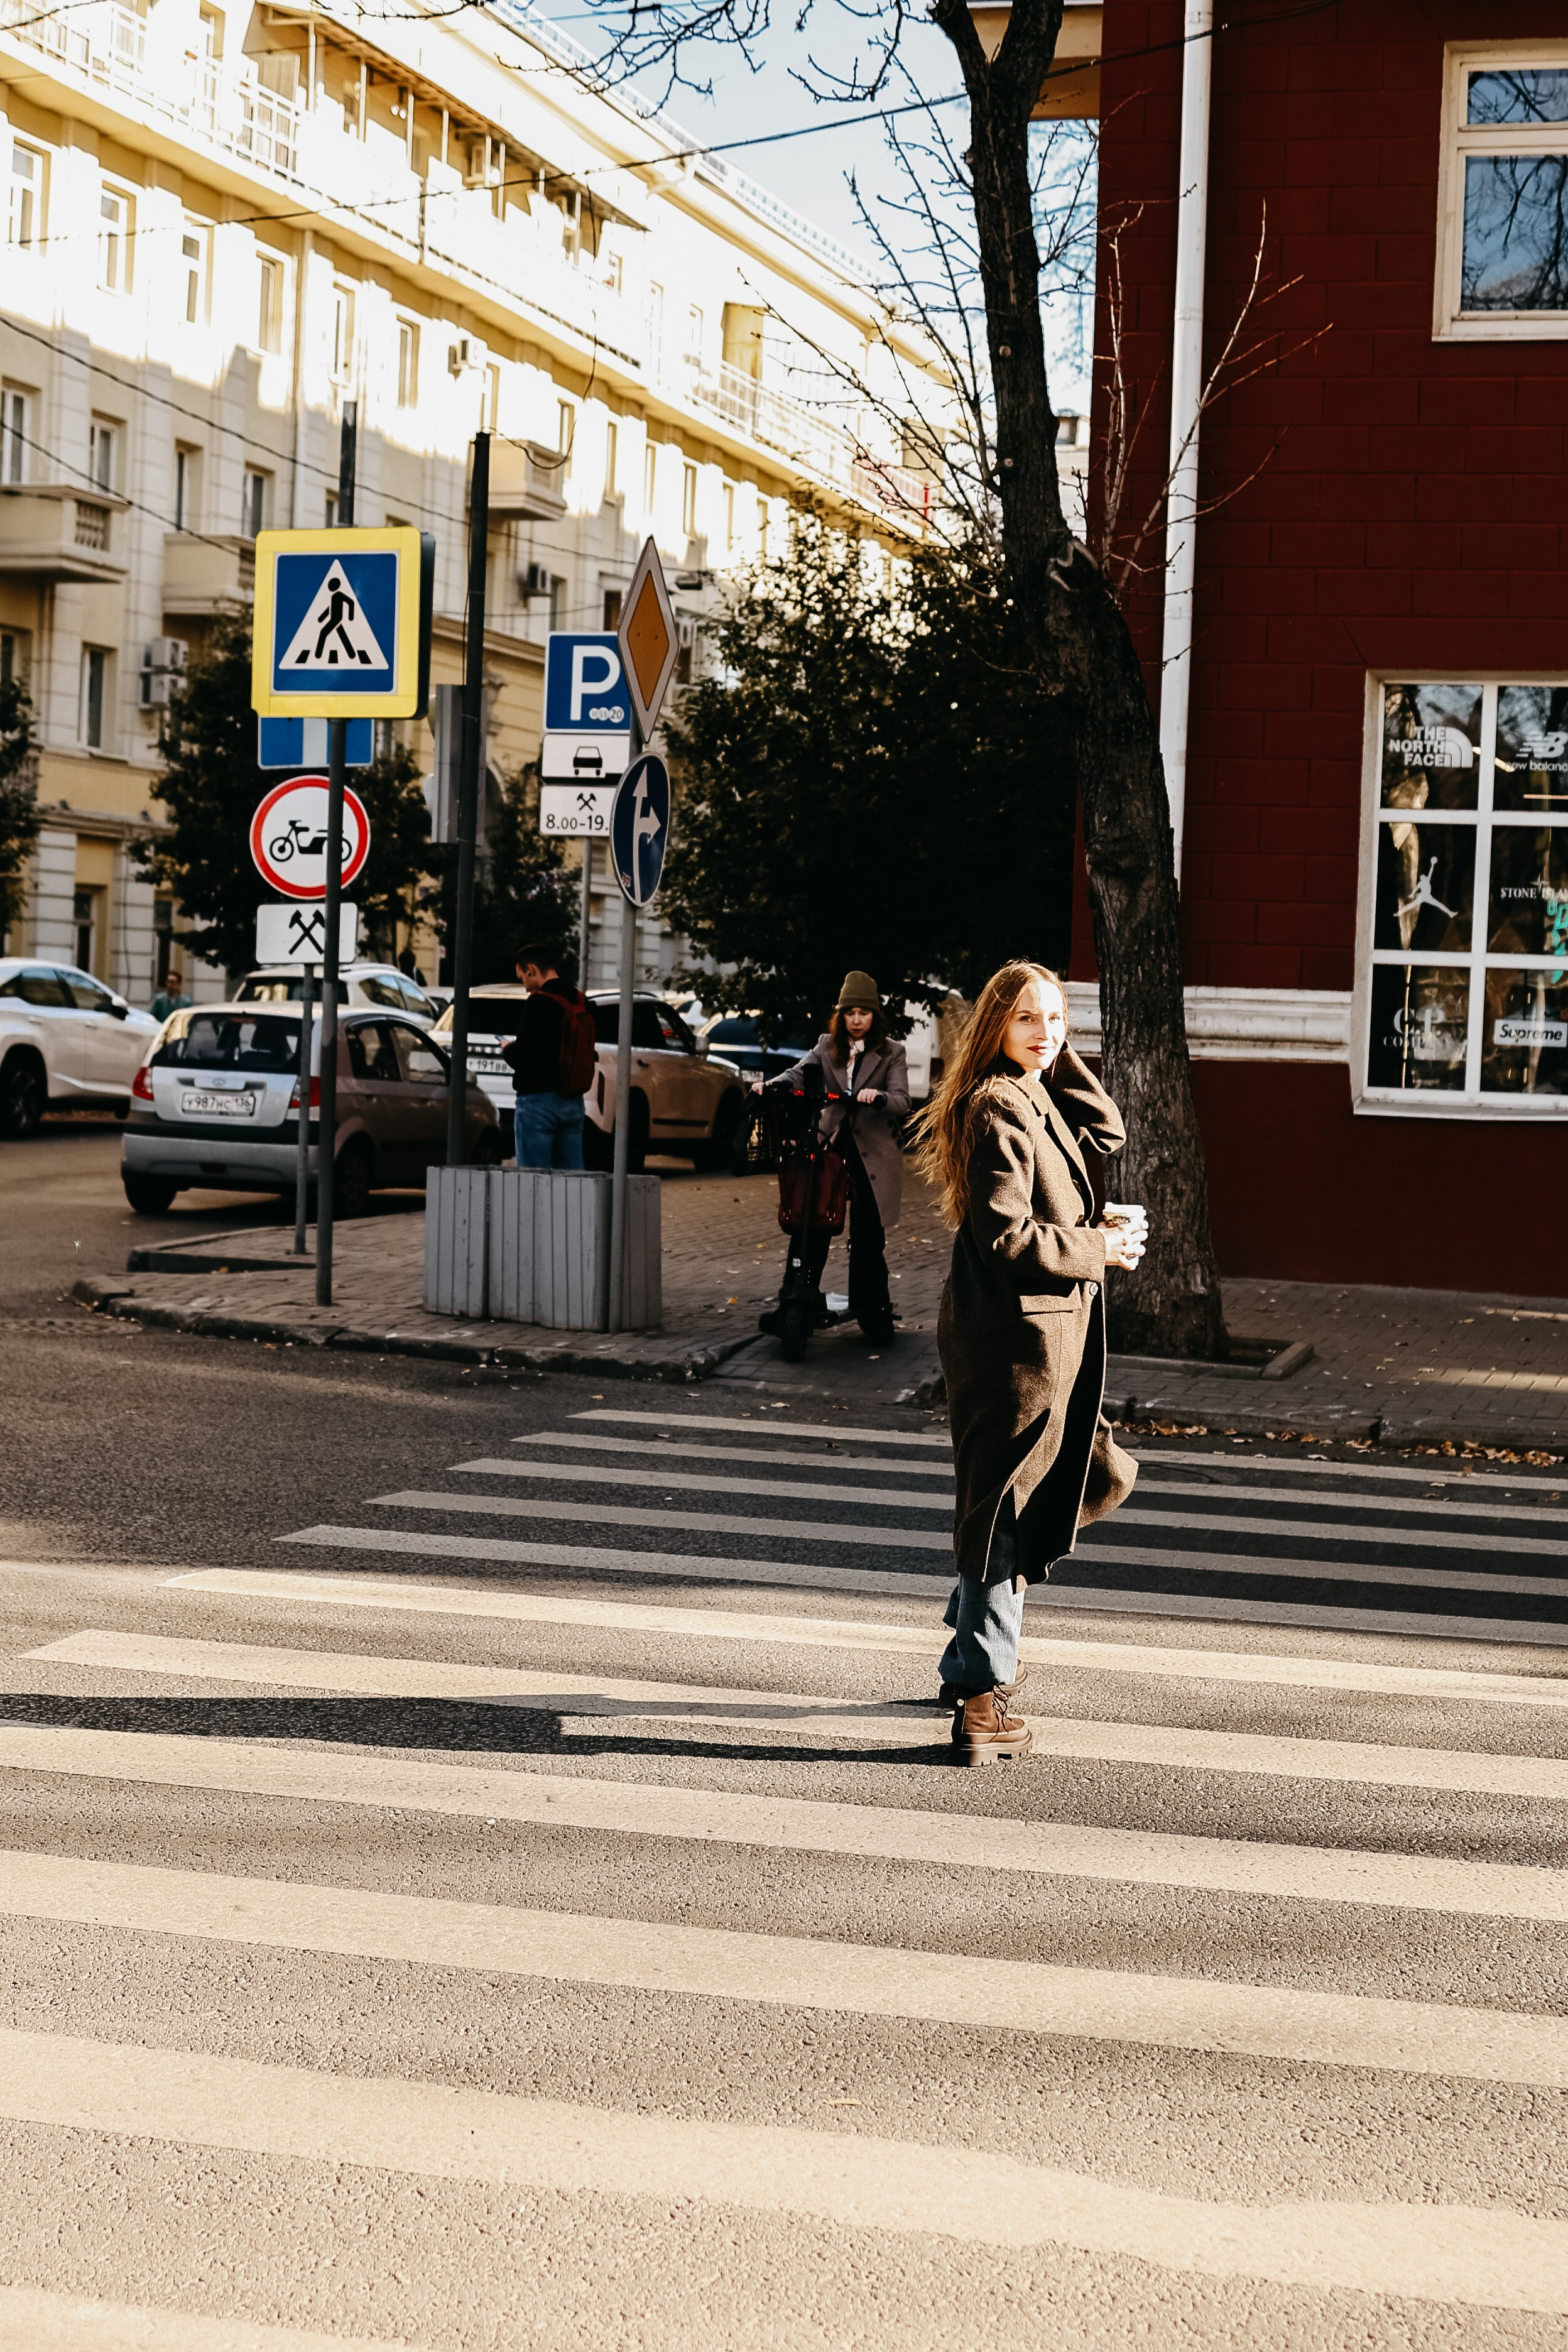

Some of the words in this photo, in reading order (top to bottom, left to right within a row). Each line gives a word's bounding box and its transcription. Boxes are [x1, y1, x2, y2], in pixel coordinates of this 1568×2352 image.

[570, 645, 620, 721] P
[611, 709, 623, 719] 20
[1415, 726, 1446, 740] THE
[1389, 739, 1446, 753] NORTH
[1404, 753, 1446, 767] FACE
[1501, 887, 1537, 900] STONE
[1393, 1008, 1446, 1035] C.P.
[1500, 1024, 1563, 1043] Supreme
